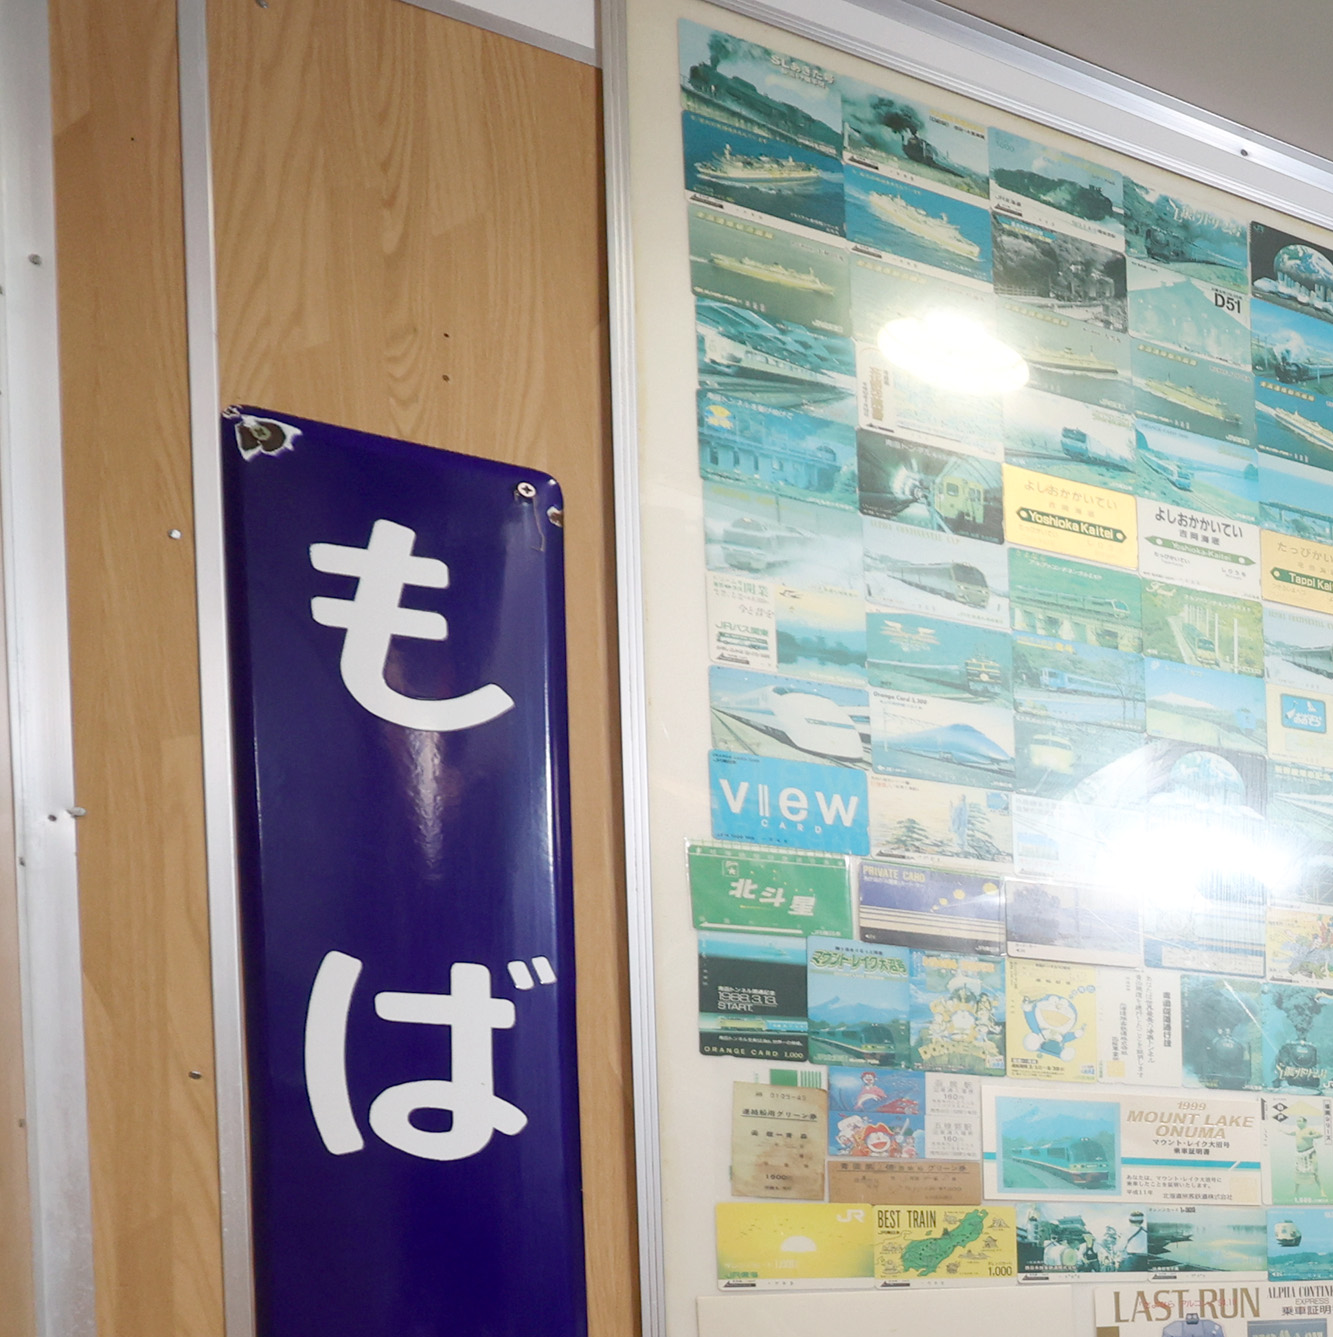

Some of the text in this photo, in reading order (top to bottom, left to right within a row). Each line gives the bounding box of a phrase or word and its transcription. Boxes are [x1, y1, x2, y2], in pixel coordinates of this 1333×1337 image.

[1213, 293, 1242, 315] D51
[1023, 479, 1118, 511] よしおかかいてい
[1028, 510, 1115, 541] Yoshioka Kaitei
[1155, 506, 1243, 539] よしおかかいてい
[1179, 529, 1220, 546] 吉岡海底
[1288, 571, 1316, 587] Tappi
[761, 818, 823, 835] CARD
[863, 866, 926, 882] PRIVATE CARD
[729, 878, 817, 917] 北斗星
[704, 1046, 779, 1057] ORANGE CARD
[1177, 1101, 1207, 1111] 1999
[1126, 1109, 1255, 1128] MOUNT LAKE
[1155, 1125, 1226, 1140] ONUMA
[836, 1208, 866, 1224] JR
[877, 1209, 937, 1229] BEST TRAIN
[1267, 1286, 1296, 1298] ALPHA
[1113, 1287, 1261, 1323] LAST RUN
